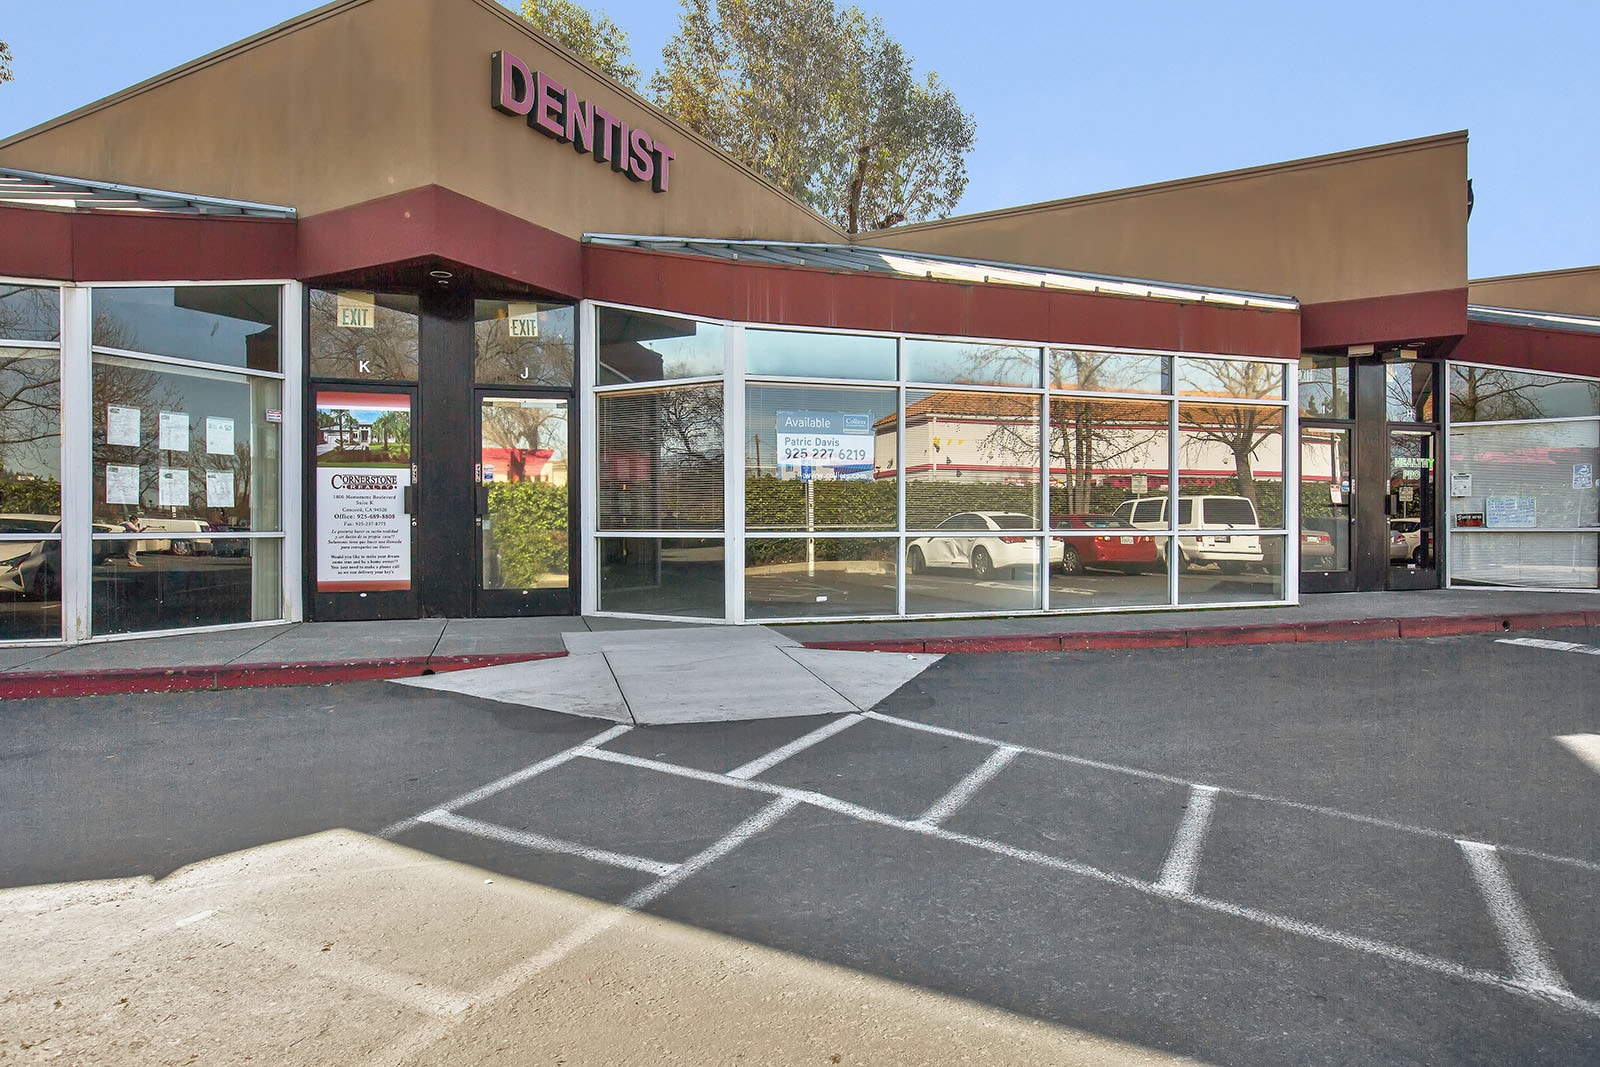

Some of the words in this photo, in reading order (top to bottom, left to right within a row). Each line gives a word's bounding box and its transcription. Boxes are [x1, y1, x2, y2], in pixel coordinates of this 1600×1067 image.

[491, 50, 676, 193] DENTIST
[342, 308, 368, 326] EXIT
[512, 318, 536, 336] EXIT
[359, 360, 370, 372] K
[520, 367, 529, 378] J
[785, 417, 830, 428] Available
[785, 437, 811, 446] Patric
[815, 438, 839, 446] Davis
[785, 448, 808, 459] 925
[812, 449, 834, 459] 227
[839, 449, 865, 460] 6219
[1395, 458, 1434, 469] HEALTHY
[1403, 470, 1420, 480] PRO
[331, 474, 397, 489] CORNERSTONE
